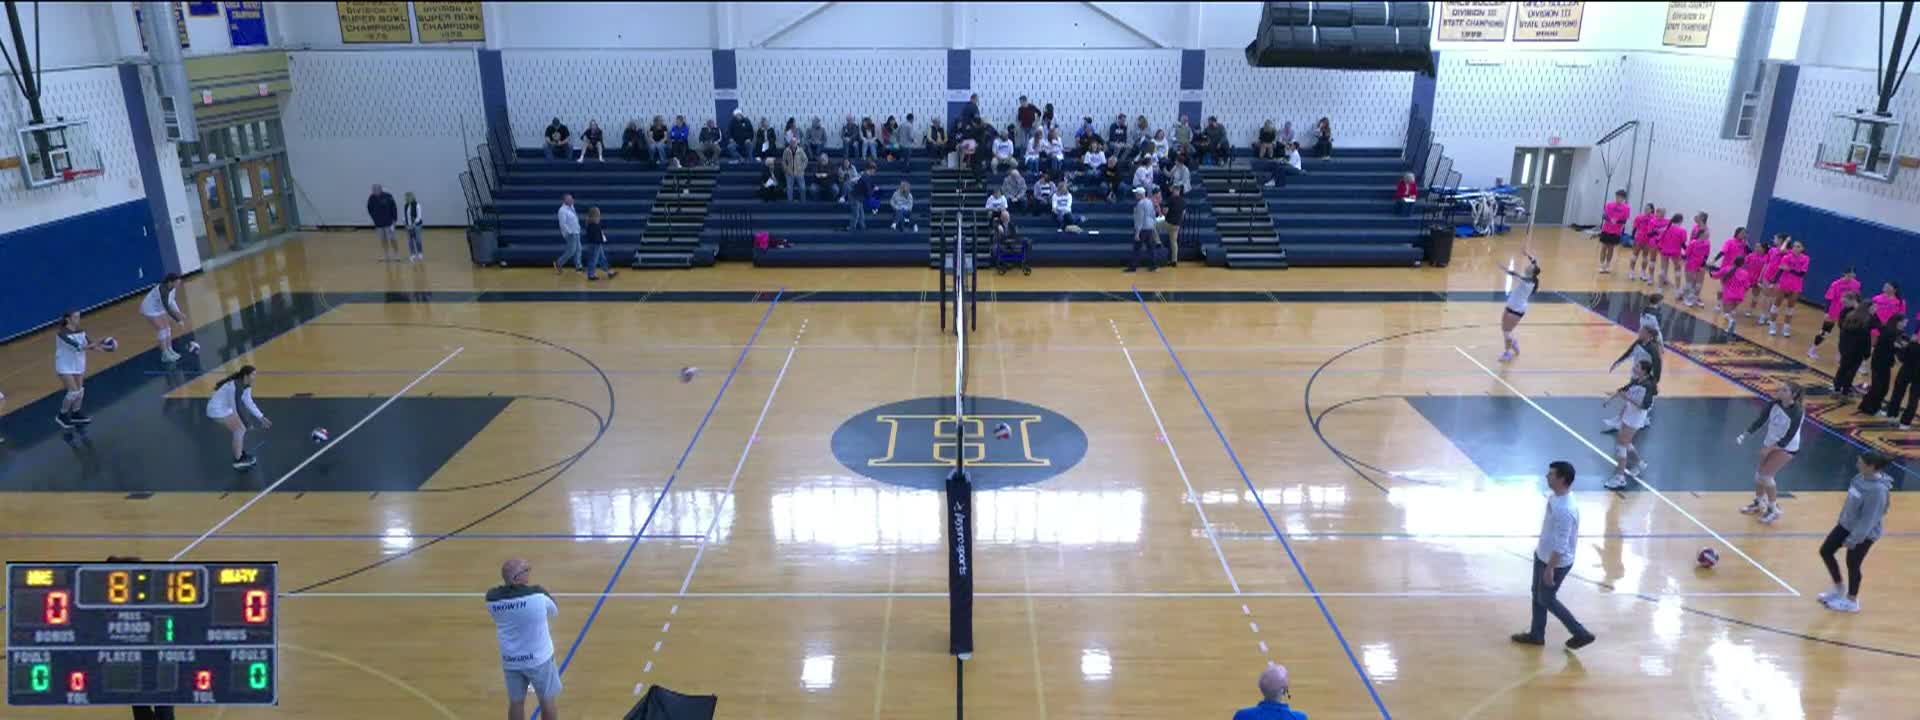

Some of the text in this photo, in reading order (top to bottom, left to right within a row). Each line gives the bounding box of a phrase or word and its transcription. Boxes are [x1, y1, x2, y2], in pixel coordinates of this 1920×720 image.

[1527, 9, 1571, 17] DIVISION III
[418, 14, 451, 22] SUPER
[423, 22, 480, 31] CHAMPIONS
[1466, 19, 1504, 27] CHAMPIONS
[1519, 20, 1578, 28] STATE CHAMPIONS
[346, 24, 405, 32] CHAMPIONS
